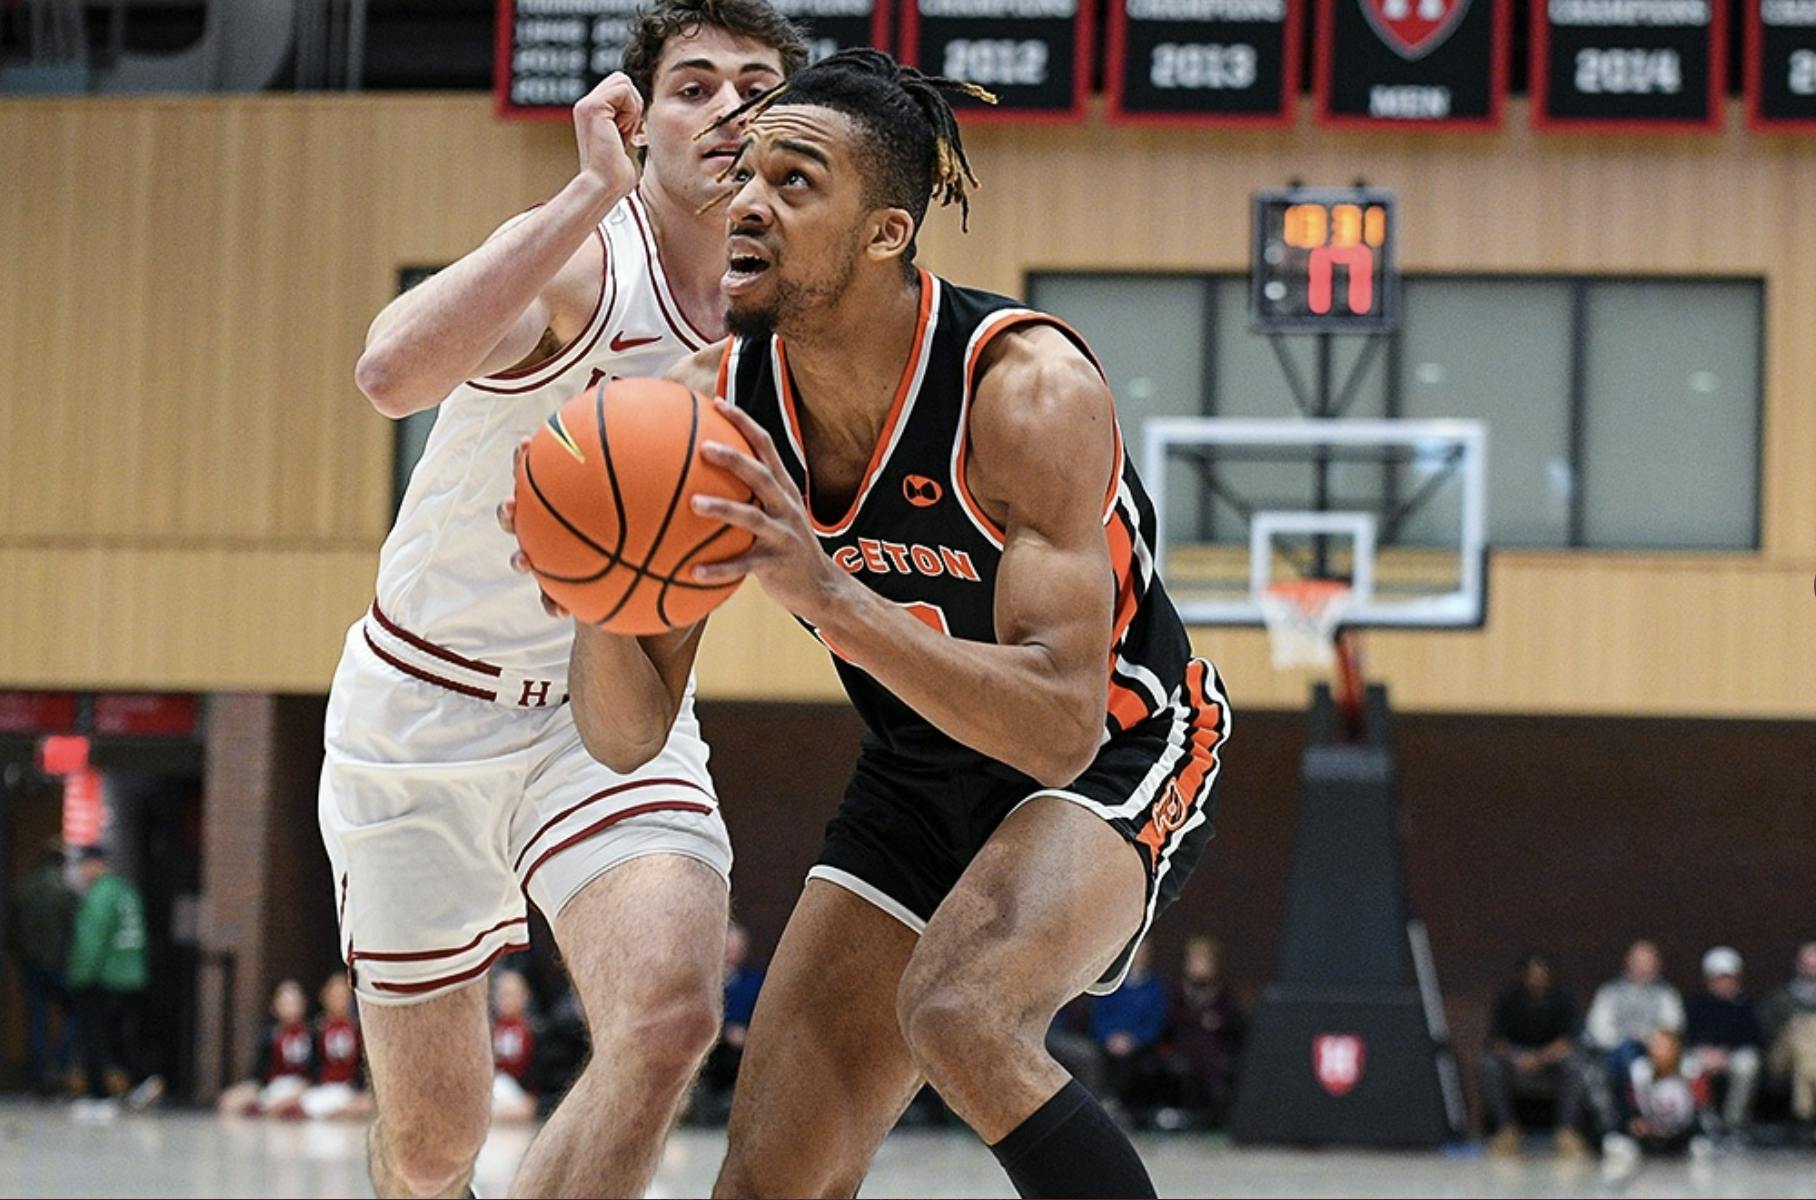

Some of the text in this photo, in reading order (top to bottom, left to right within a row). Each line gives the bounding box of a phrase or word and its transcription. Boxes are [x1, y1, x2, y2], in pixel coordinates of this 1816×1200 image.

[944, 40, 1048, 84] 2012
[1150, 43, 1257, 89] 2013
[1575, 47, 1682, 94] 2014
[1369, 85, 1451, 118] MEN
[518, 680, 551, 707] H
